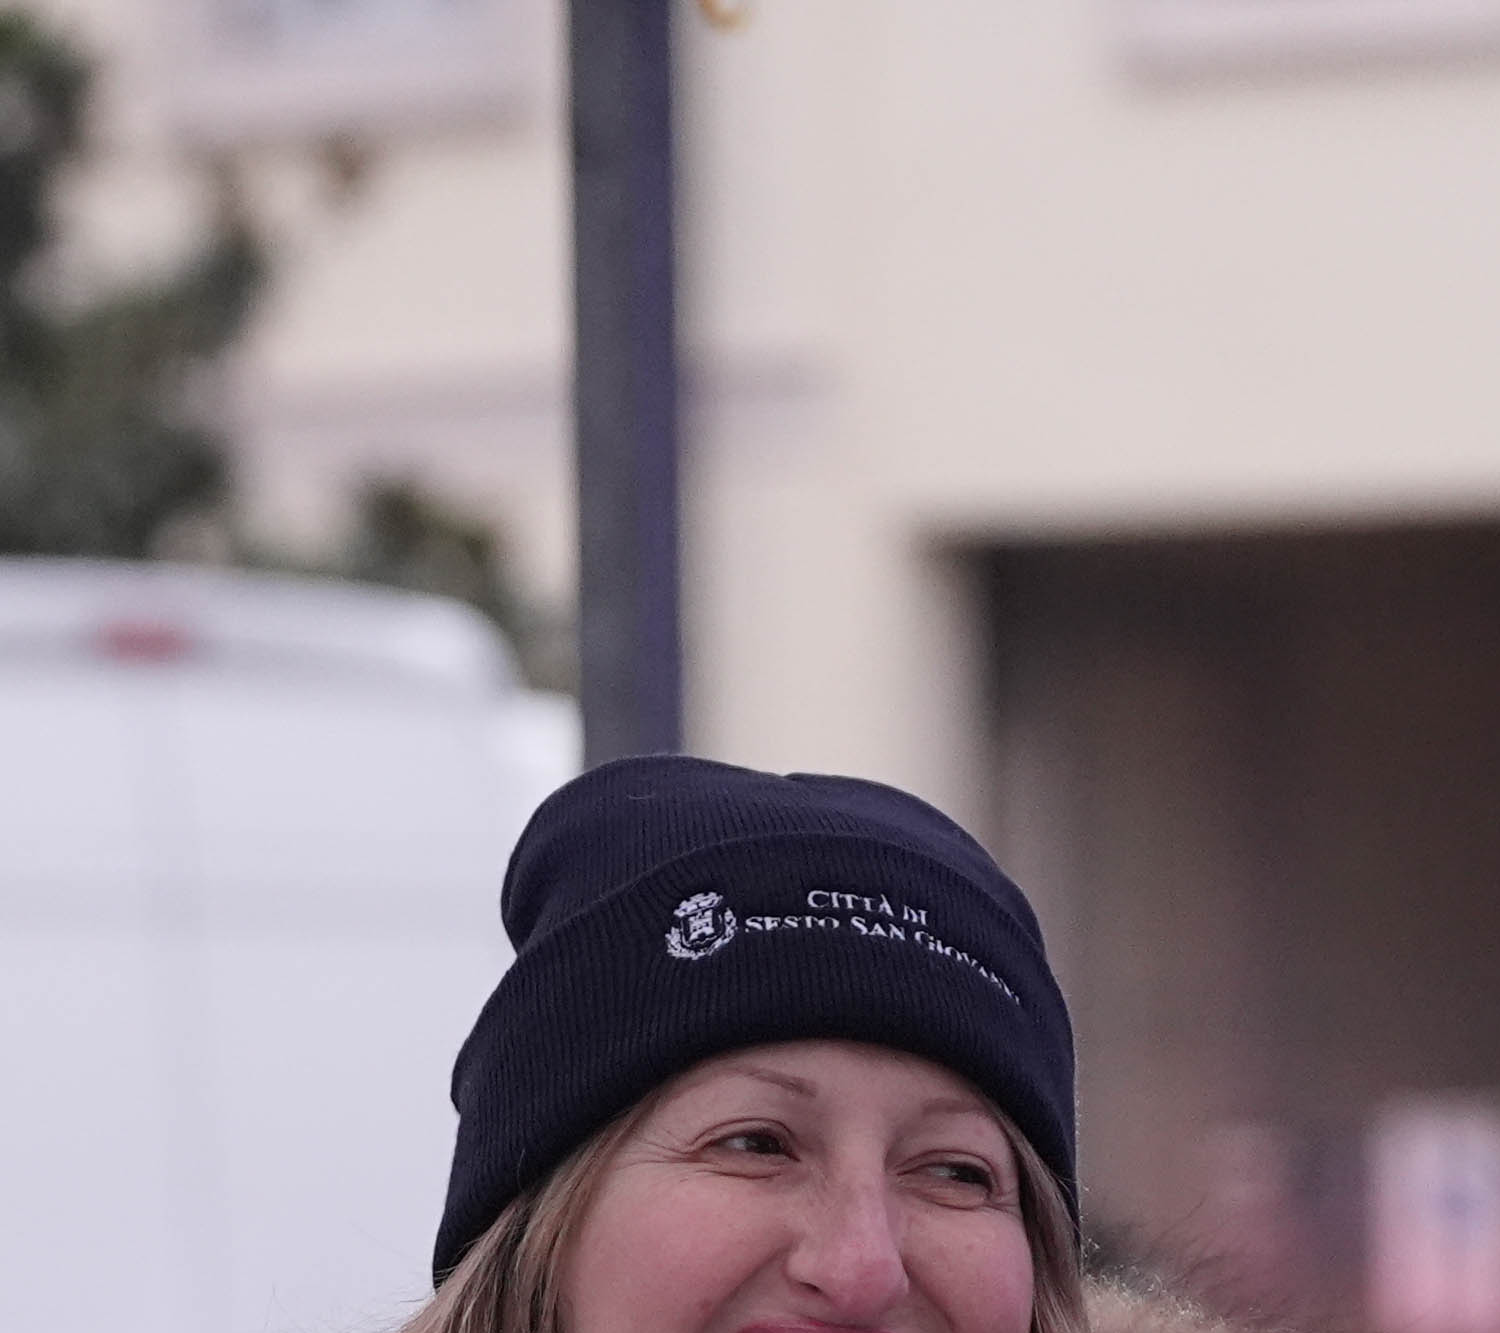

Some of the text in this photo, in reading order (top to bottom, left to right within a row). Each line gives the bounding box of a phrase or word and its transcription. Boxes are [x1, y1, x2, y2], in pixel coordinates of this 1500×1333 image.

[807, 889, 928, 925] CITTÀ DI
[745, 915, 840, 933] SESTO
[850, 916, 906, 941] SAN
